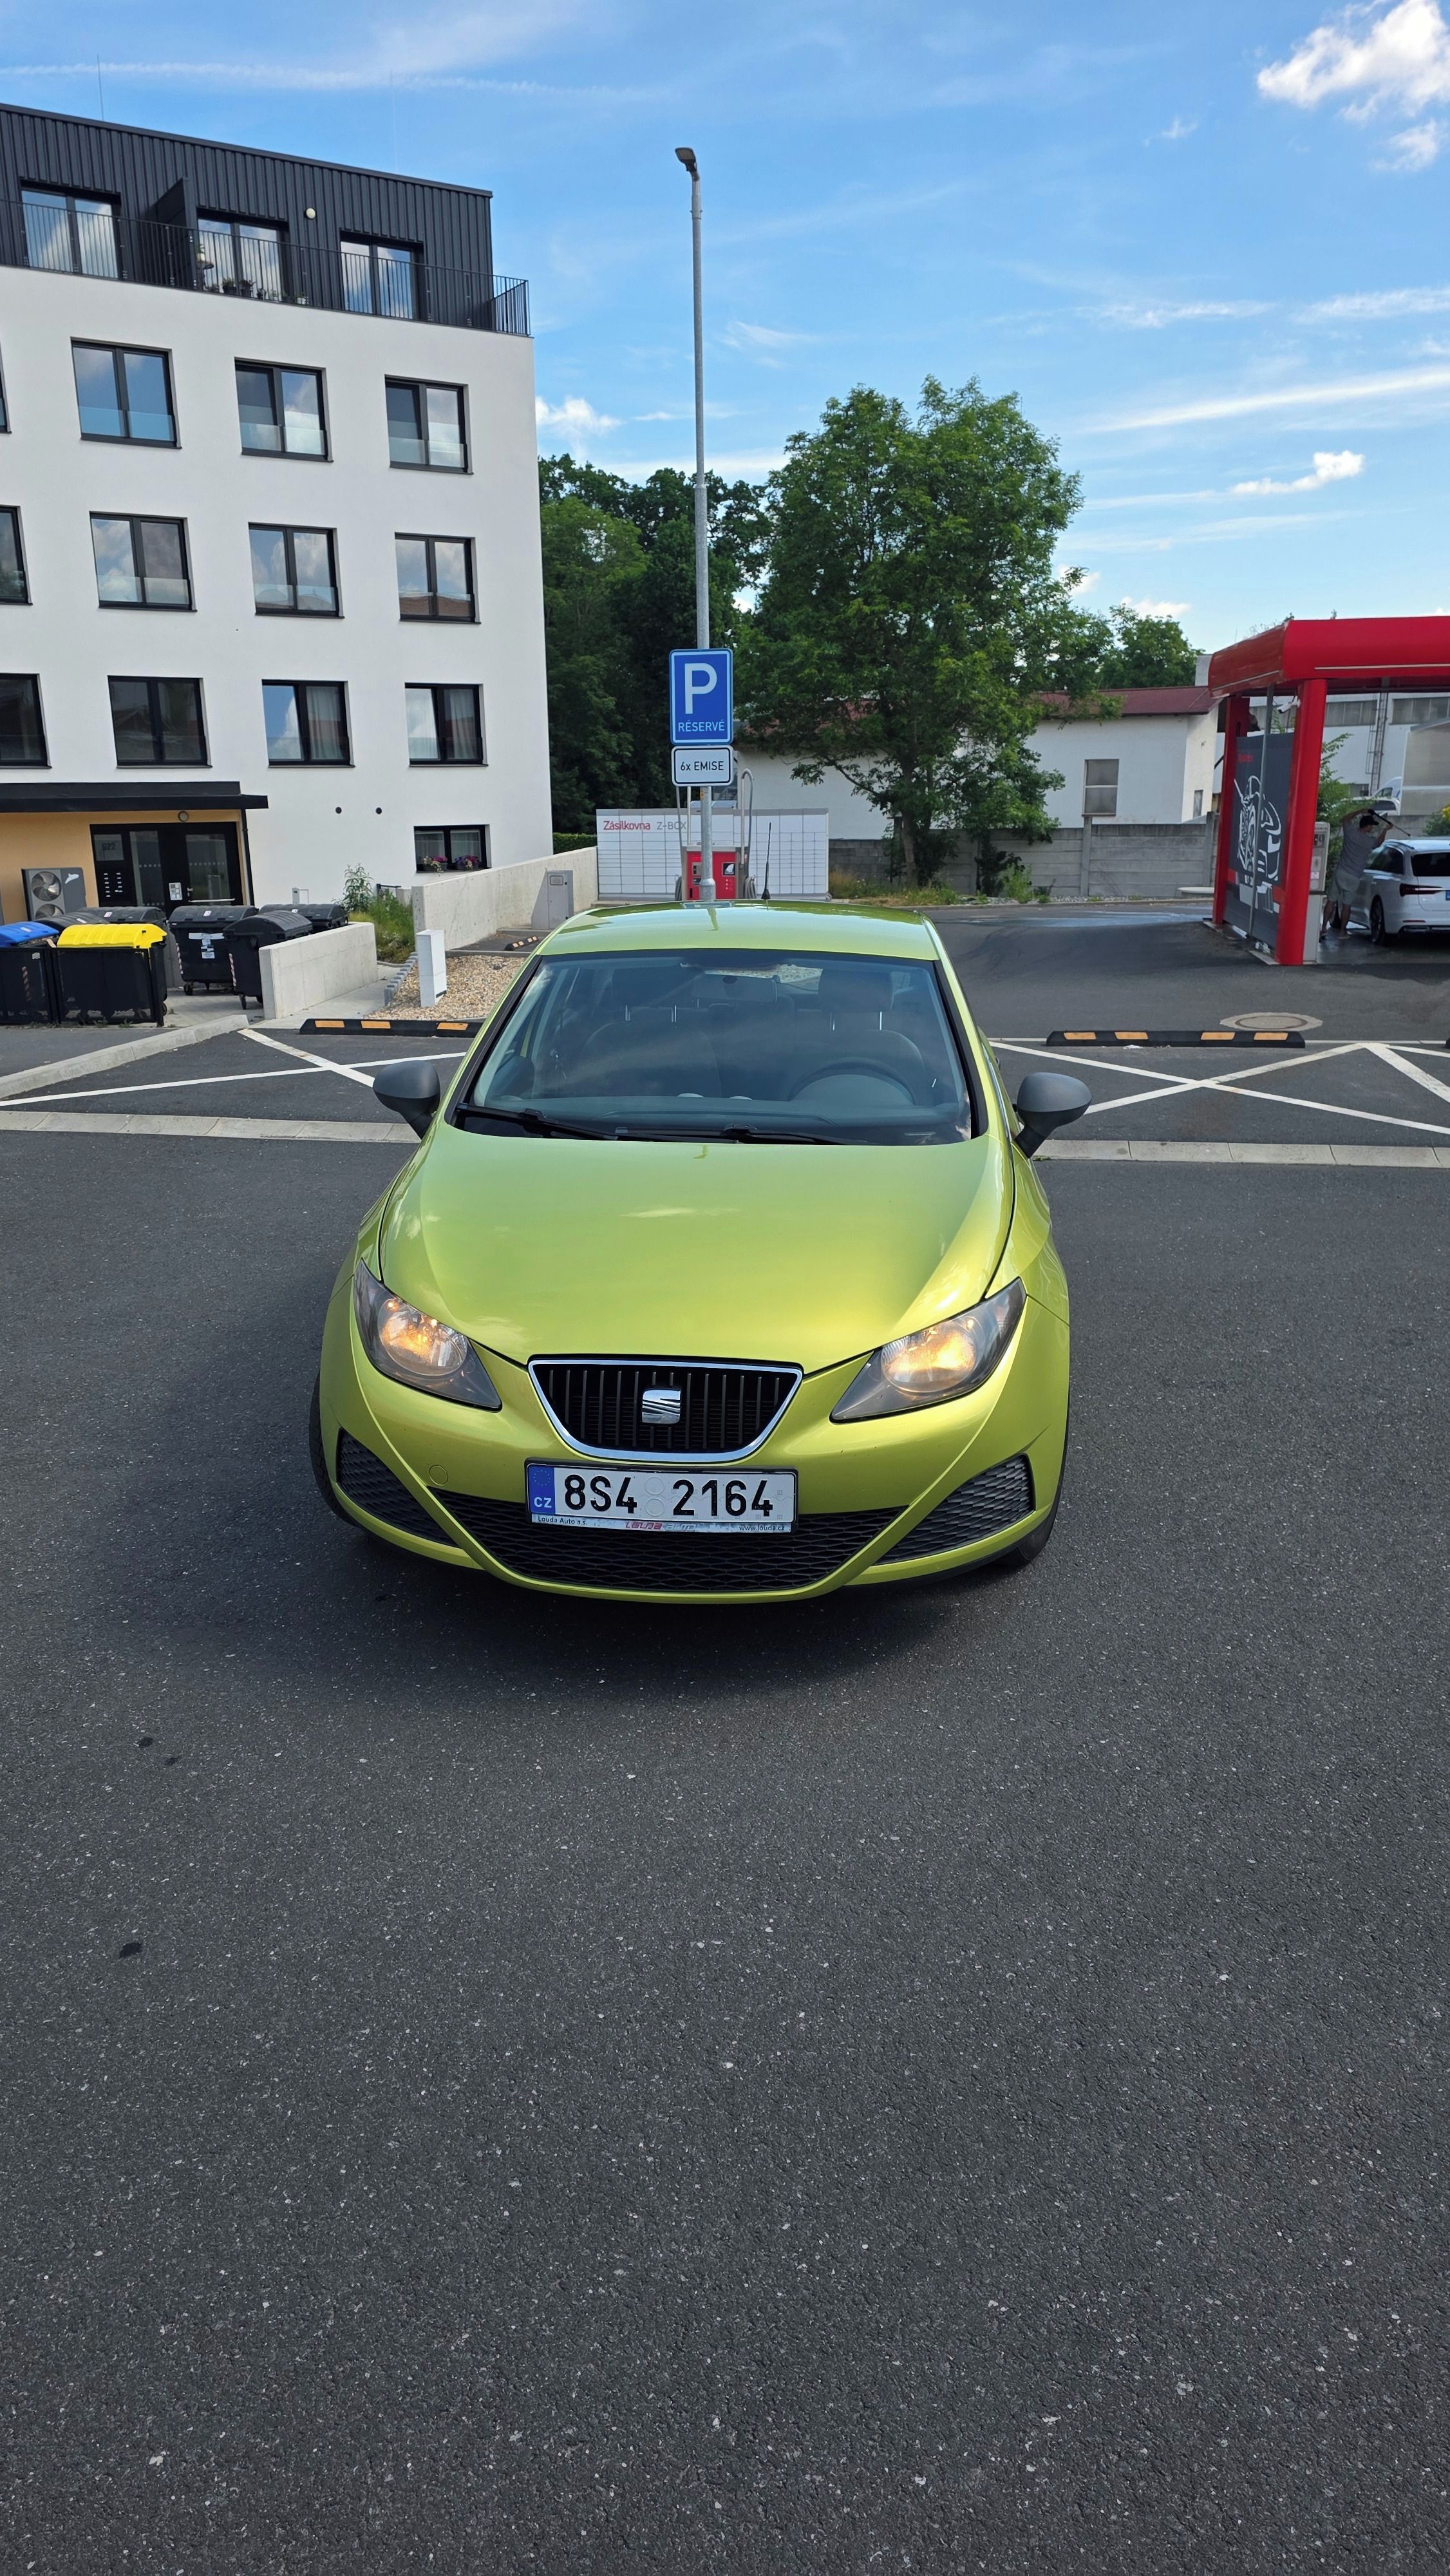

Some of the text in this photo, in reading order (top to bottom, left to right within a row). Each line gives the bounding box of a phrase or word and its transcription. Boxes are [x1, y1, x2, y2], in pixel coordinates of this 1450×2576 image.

[684, 663, 717, 714] P
[678, 719, 725, 732] RÉSERVÉ
[681, 761, 724, 771] 6x EMISE
[603, 820, 687, 830] Zásilkovna Z-BOX
[534, 1474, 773, 1517] CZ 8S4 2164
